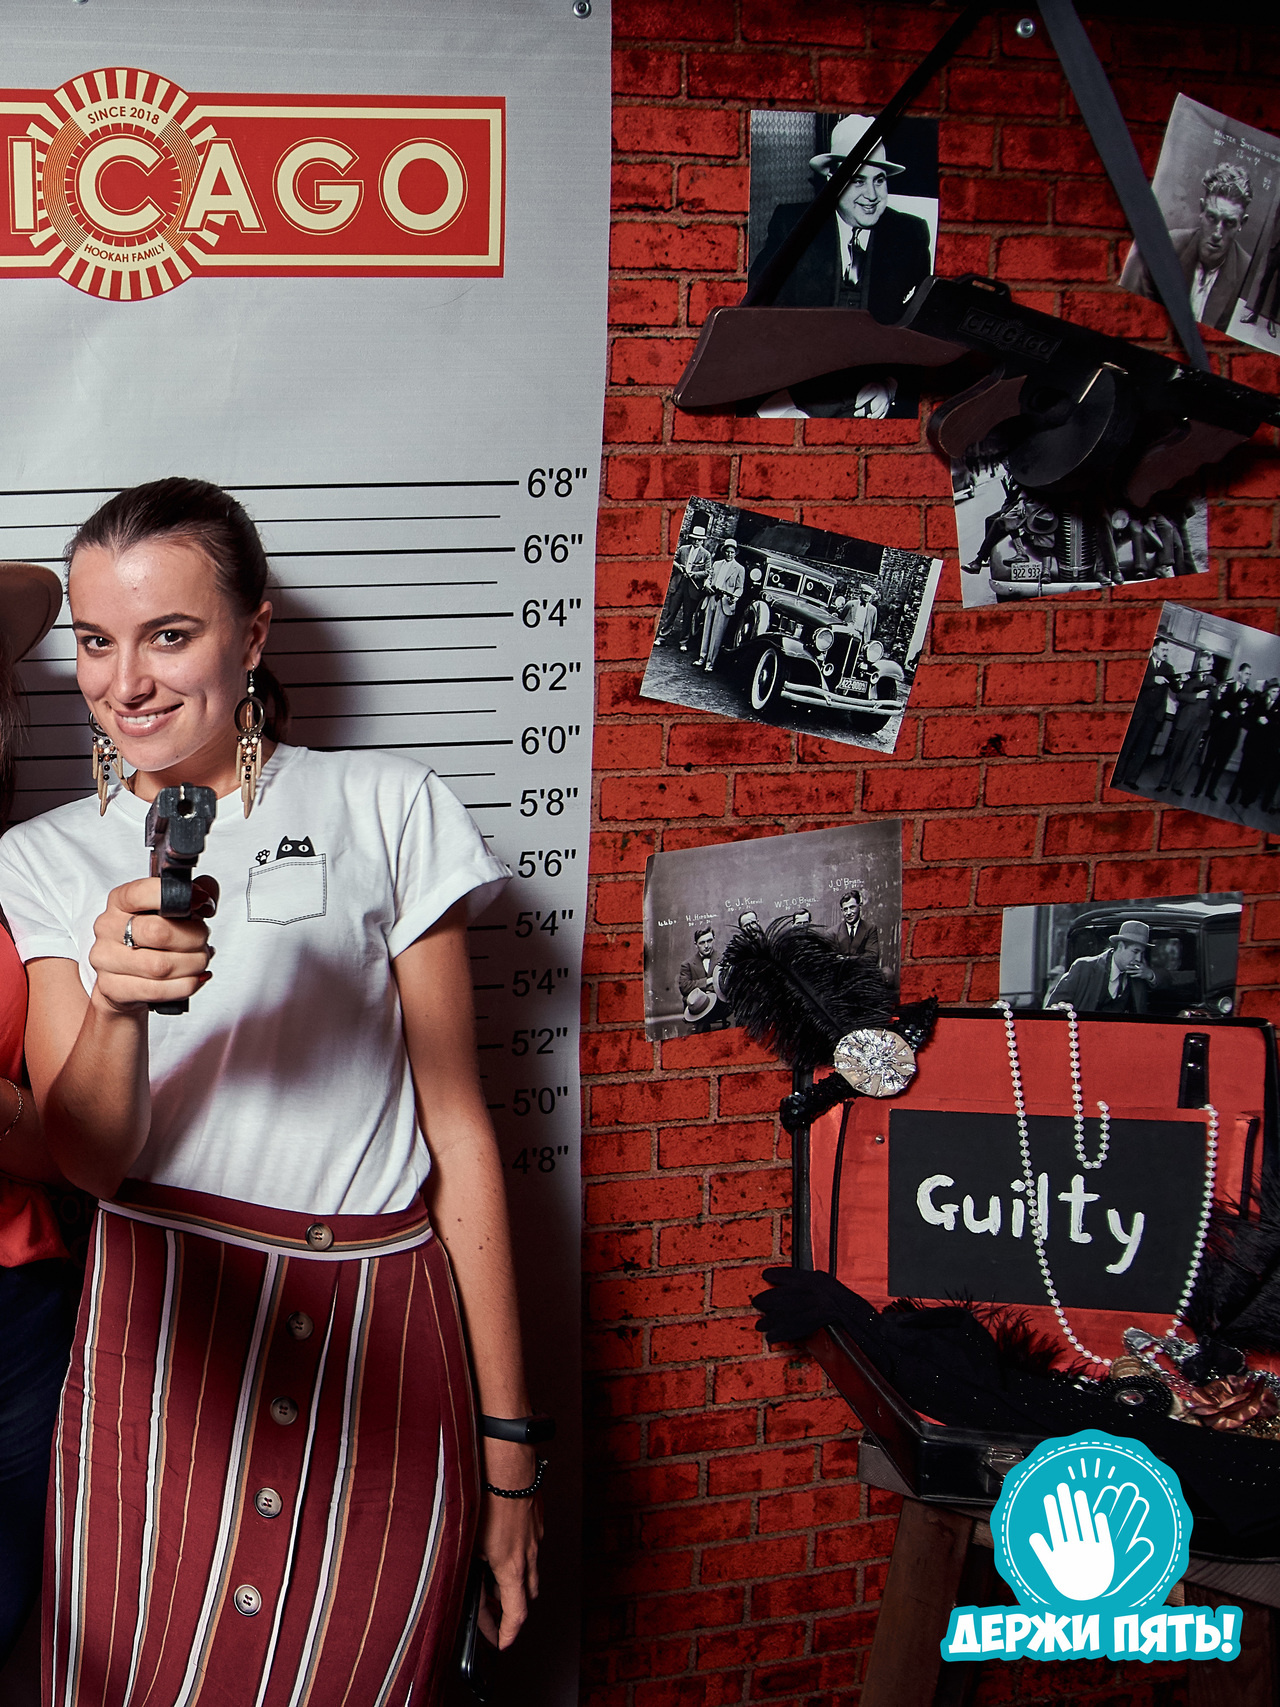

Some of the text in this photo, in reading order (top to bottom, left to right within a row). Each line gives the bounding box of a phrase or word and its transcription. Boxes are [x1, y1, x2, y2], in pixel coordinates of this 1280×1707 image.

[88, 106, 160, 124] SINCE 2018
[84, 243, 165, 262] HOOKAH FAMILY
[527, 467, 588, 498] 6'8"
[524, 534, 583, 563] 6'6"
[522, 598, 582, 628] 6'4"
[522, 662, 581, 692] 6'2"
[521, 725, 580, 755] 6'0"
[520, 787, 578, 817] 5'8"
[518, 849, 576, 878] 5'6"
[515, 909, 574, 938] 5'4"
[512, 968, 569, 997] 5'4"
[511, 1027, 568, 1056] 5'2"
[512, 1086, 569, 1116] 5'0"
[512, 1145, 569, 1174] 4'8"
[916, 1172, 1145, 1274] Guilty
